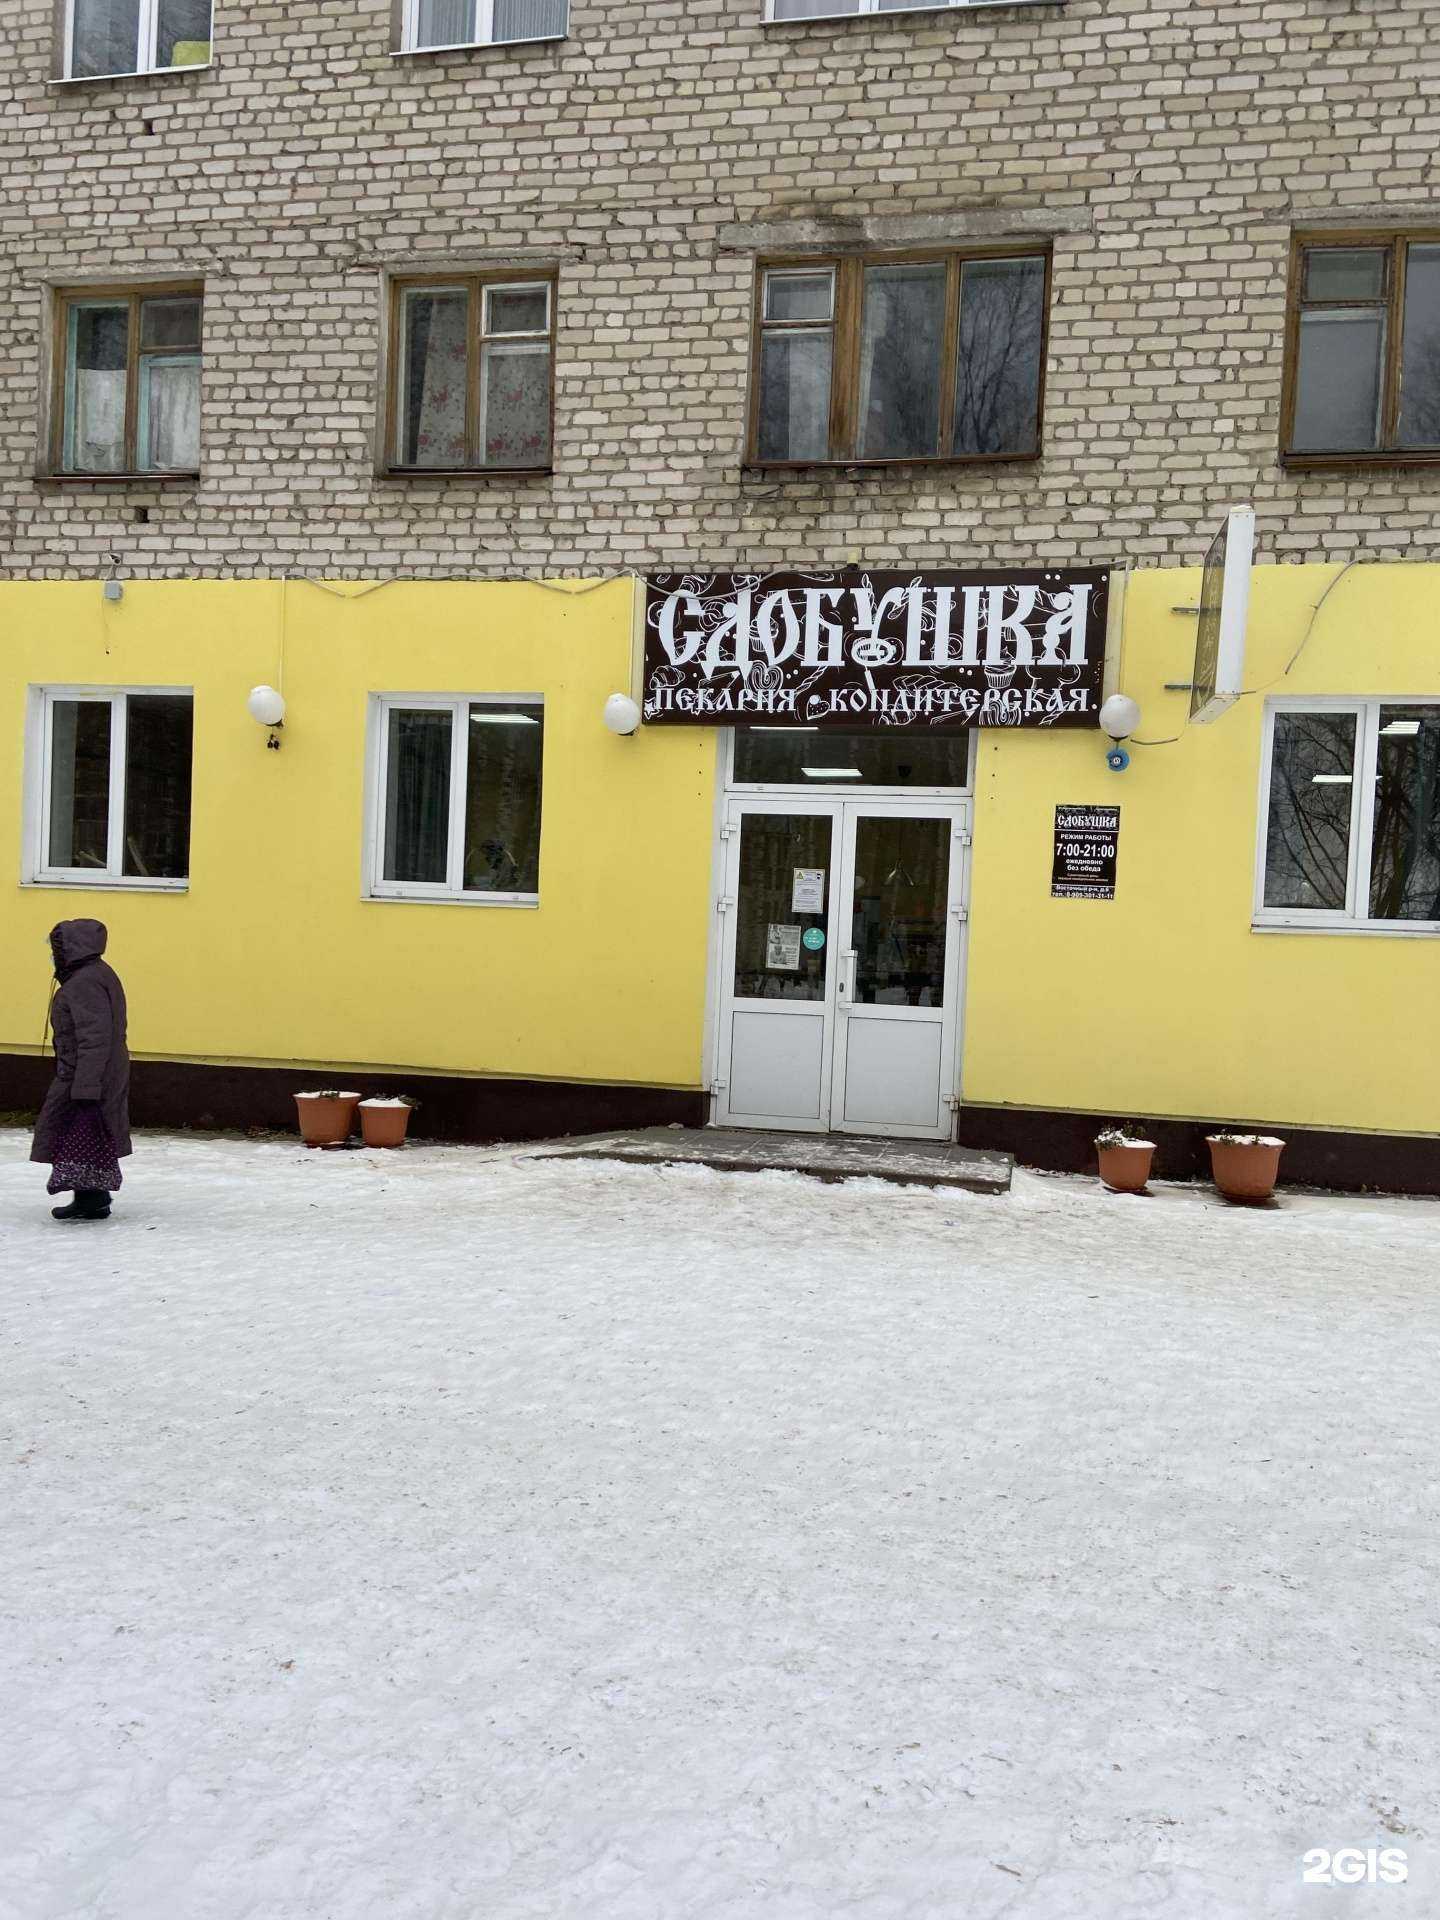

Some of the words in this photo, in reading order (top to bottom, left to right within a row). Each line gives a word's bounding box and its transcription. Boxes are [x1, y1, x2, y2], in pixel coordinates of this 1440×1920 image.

[658, 584, 1093, 682] СДОБУШКА
[653, 687, 797, 712] ПЕКАРНЯ
[828, 688, 1090, 713] КОНДИТЕРСКАЯ
[1057, 815, 1117, 828] СДОБУШКА
[1056, 843, 1115, 858] 7:00-21:00
